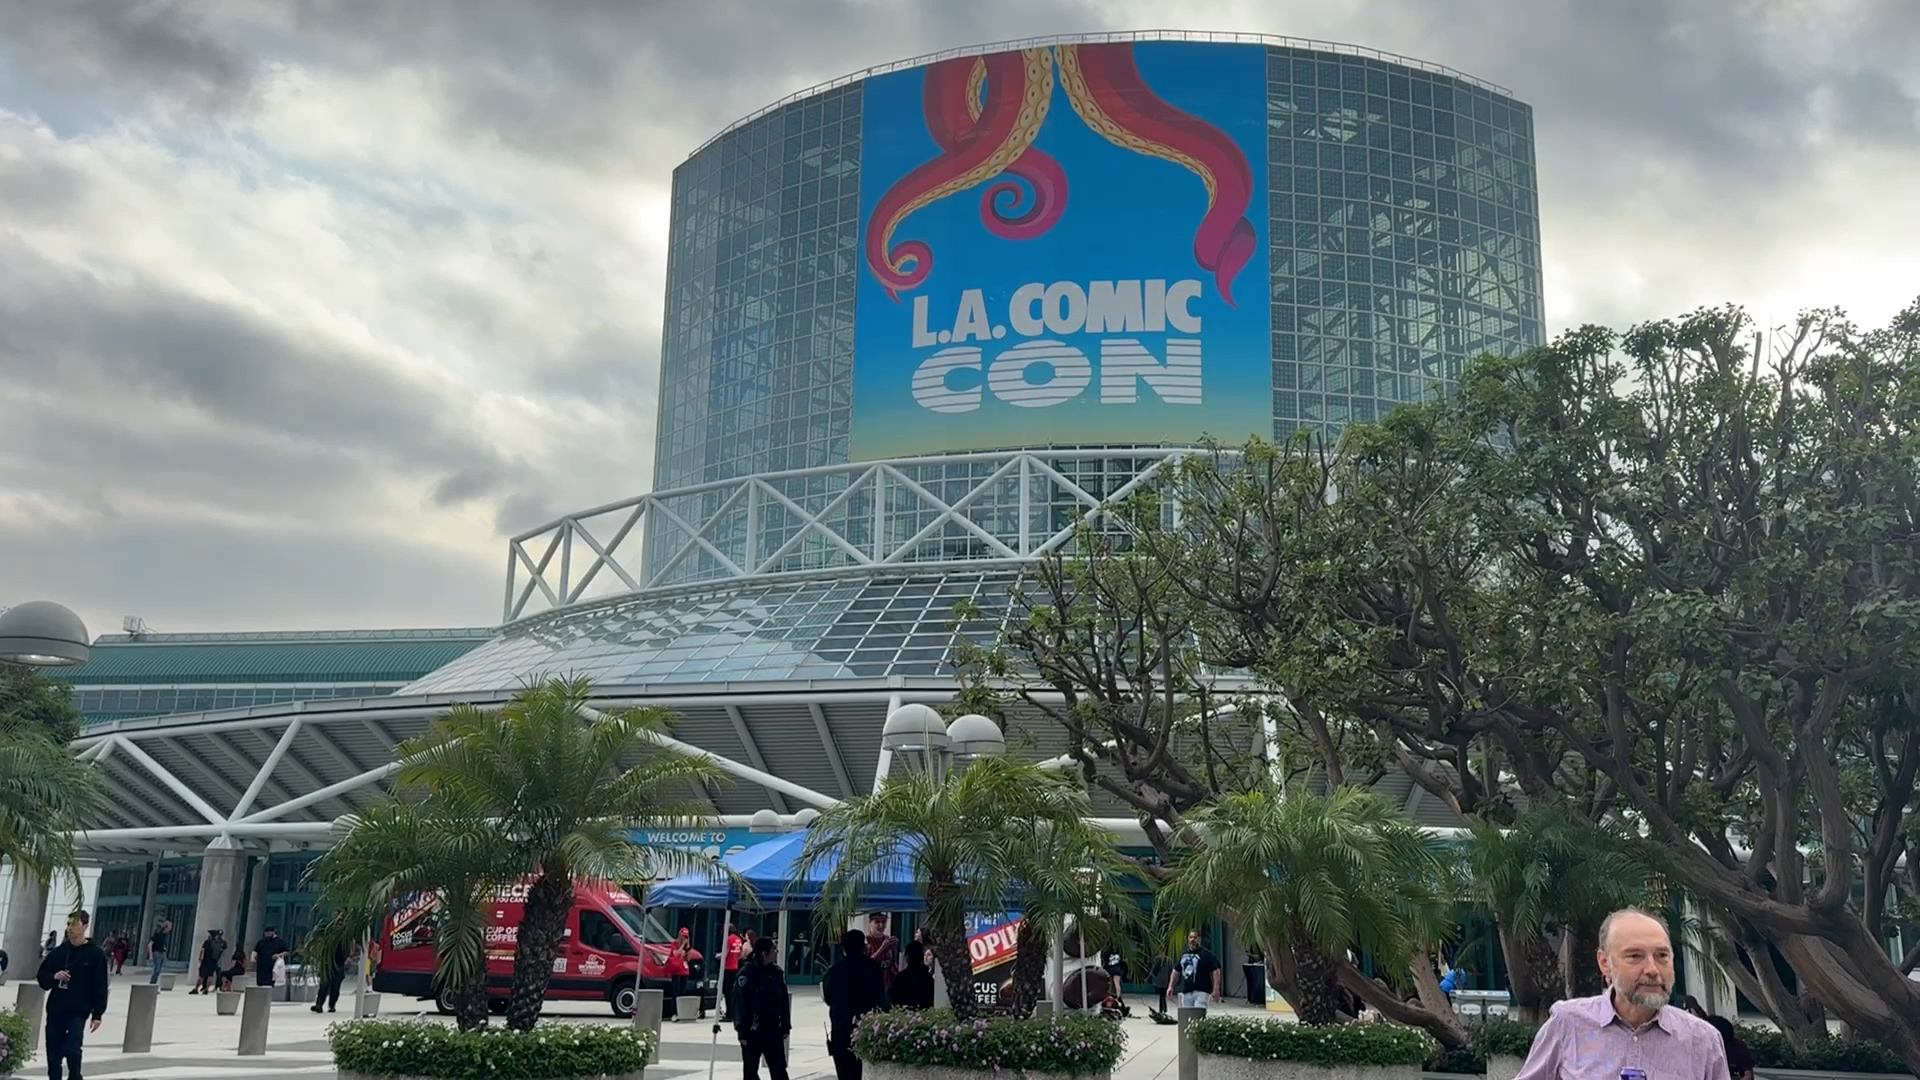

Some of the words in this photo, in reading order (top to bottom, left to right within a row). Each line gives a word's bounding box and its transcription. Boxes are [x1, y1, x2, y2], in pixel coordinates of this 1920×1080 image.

[912, 288, 1007, 348] L.A.
[1009, 279, 1202, 336] COMIC
[912, 339, 1202, 414] CON
[647, 832, 706, 843] WELCOME
[709, 832, 726, 843] TO
[486, 927, 504, 935] CUP
[505, 927, 519, 935] OF
[970, 922, 1019, 963] OPIK
[975, 994, 997, 1004] FEE
